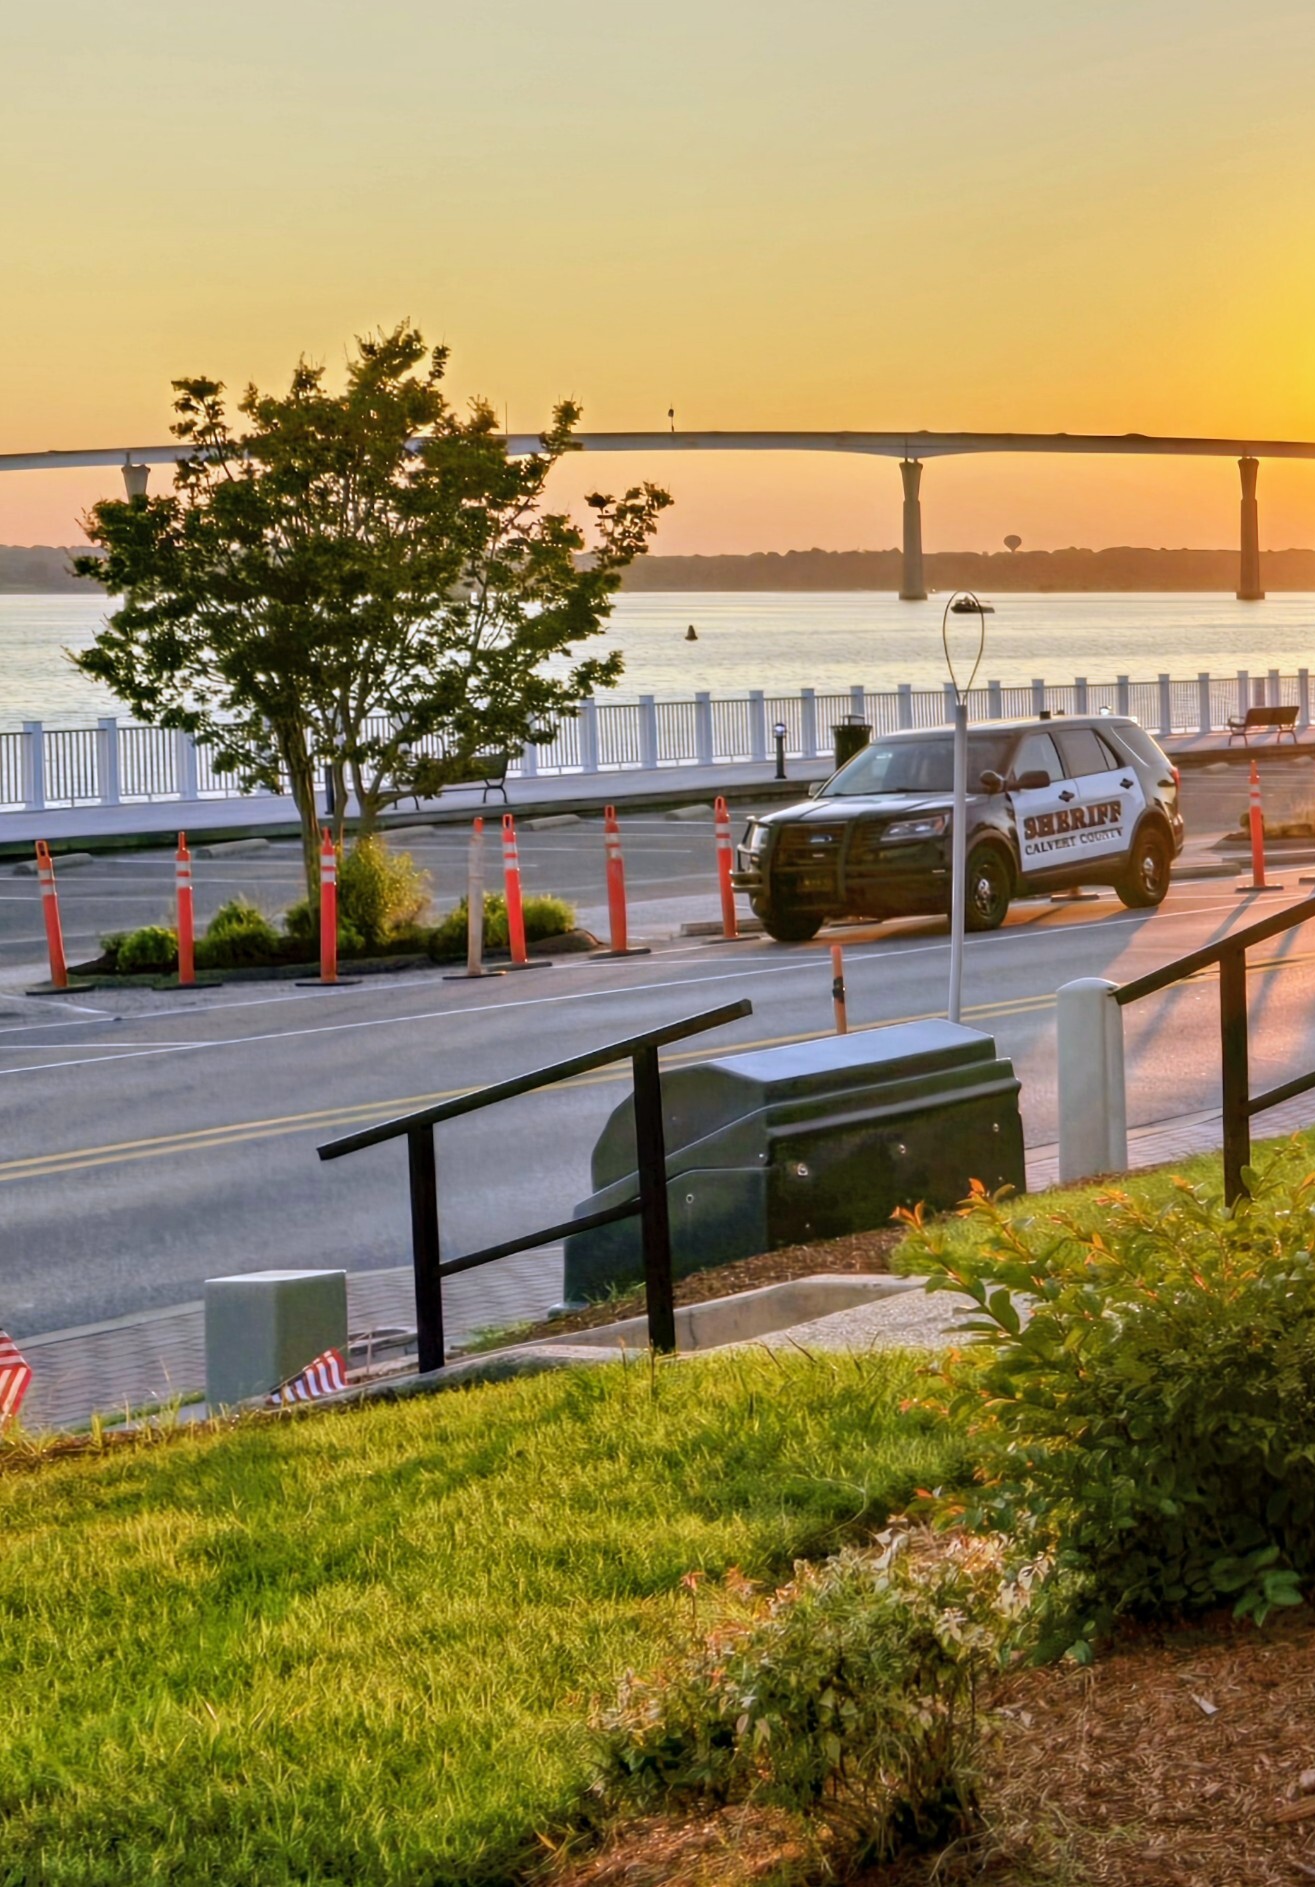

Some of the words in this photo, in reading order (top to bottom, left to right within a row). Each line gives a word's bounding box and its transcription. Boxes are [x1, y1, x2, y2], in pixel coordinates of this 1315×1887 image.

[1023, 800, 1122, 840] SHERIFF
[1025, 836, 1077, 855] CALVERT
[1080, 827, 1123, 844] COUNTY
